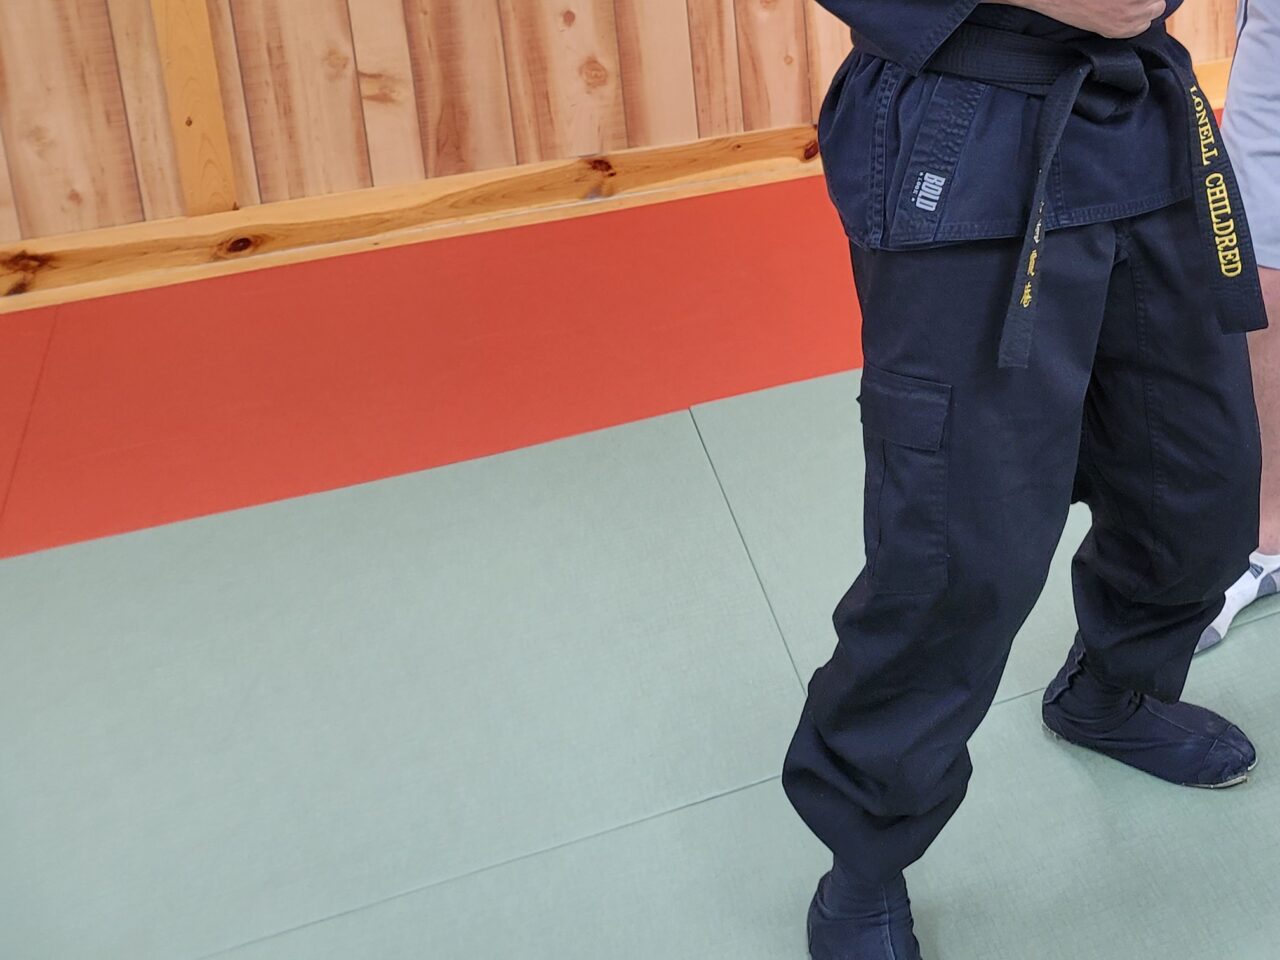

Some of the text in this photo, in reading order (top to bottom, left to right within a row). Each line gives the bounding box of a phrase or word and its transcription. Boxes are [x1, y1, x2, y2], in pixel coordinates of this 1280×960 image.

[915, 172, 946, 211] BOLD
[1190, 86, 1242, 278] LONELL CHILDRED
